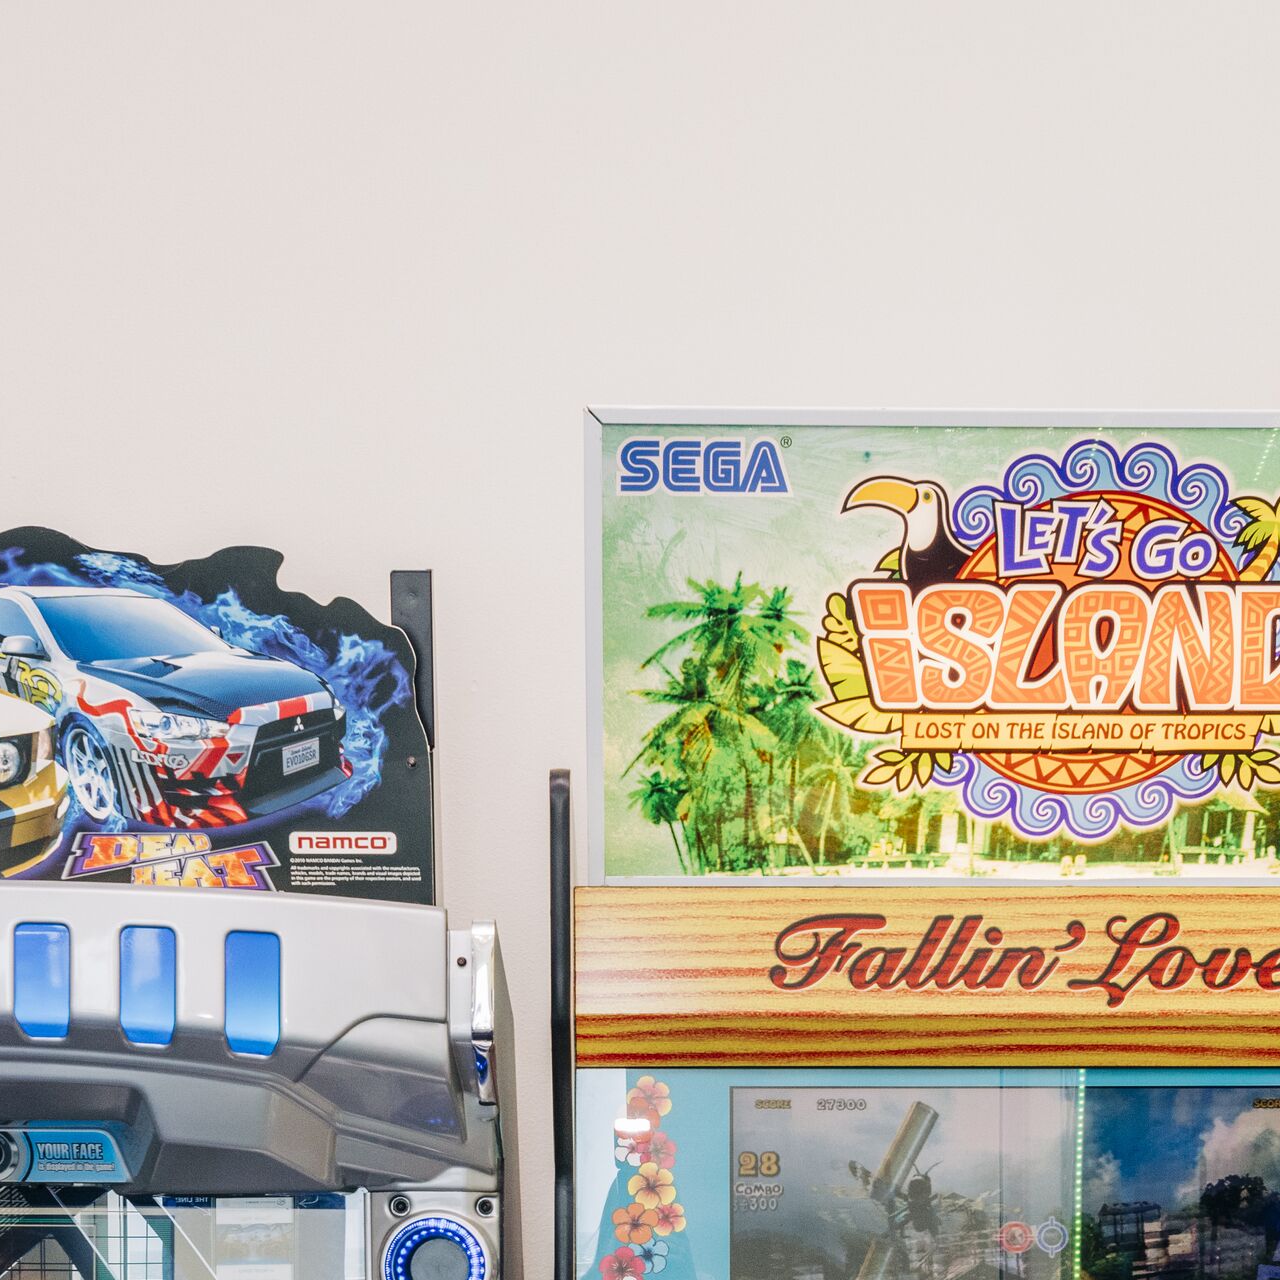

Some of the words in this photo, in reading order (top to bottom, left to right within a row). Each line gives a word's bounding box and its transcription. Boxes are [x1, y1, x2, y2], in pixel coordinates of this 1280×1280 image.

[618, 438, 791, 495] SEGA
[914, 720, 966, 741] LOST
[970, 720, 1005, 741] ON
[1006, 720, 1046, 741] THE
[1132, 721, 1157, 741] OF
[1161, 721, 1247, 741] TROPICS
[83, 834, 210, 871] DEAD
[297, 836, 388, 849] namco
[132, 847, 265, 888] HEAT
[770, 912, 1086, 994] Fallin'
[754, 1099, 792, 1110] SCORE
[816, 1098, 868, 1110] 27300
[36, 1143, 70, 1160] YOUR
[71, 1143, 104, 1160] FACE
[738, 1150, 781, 1178] 28
